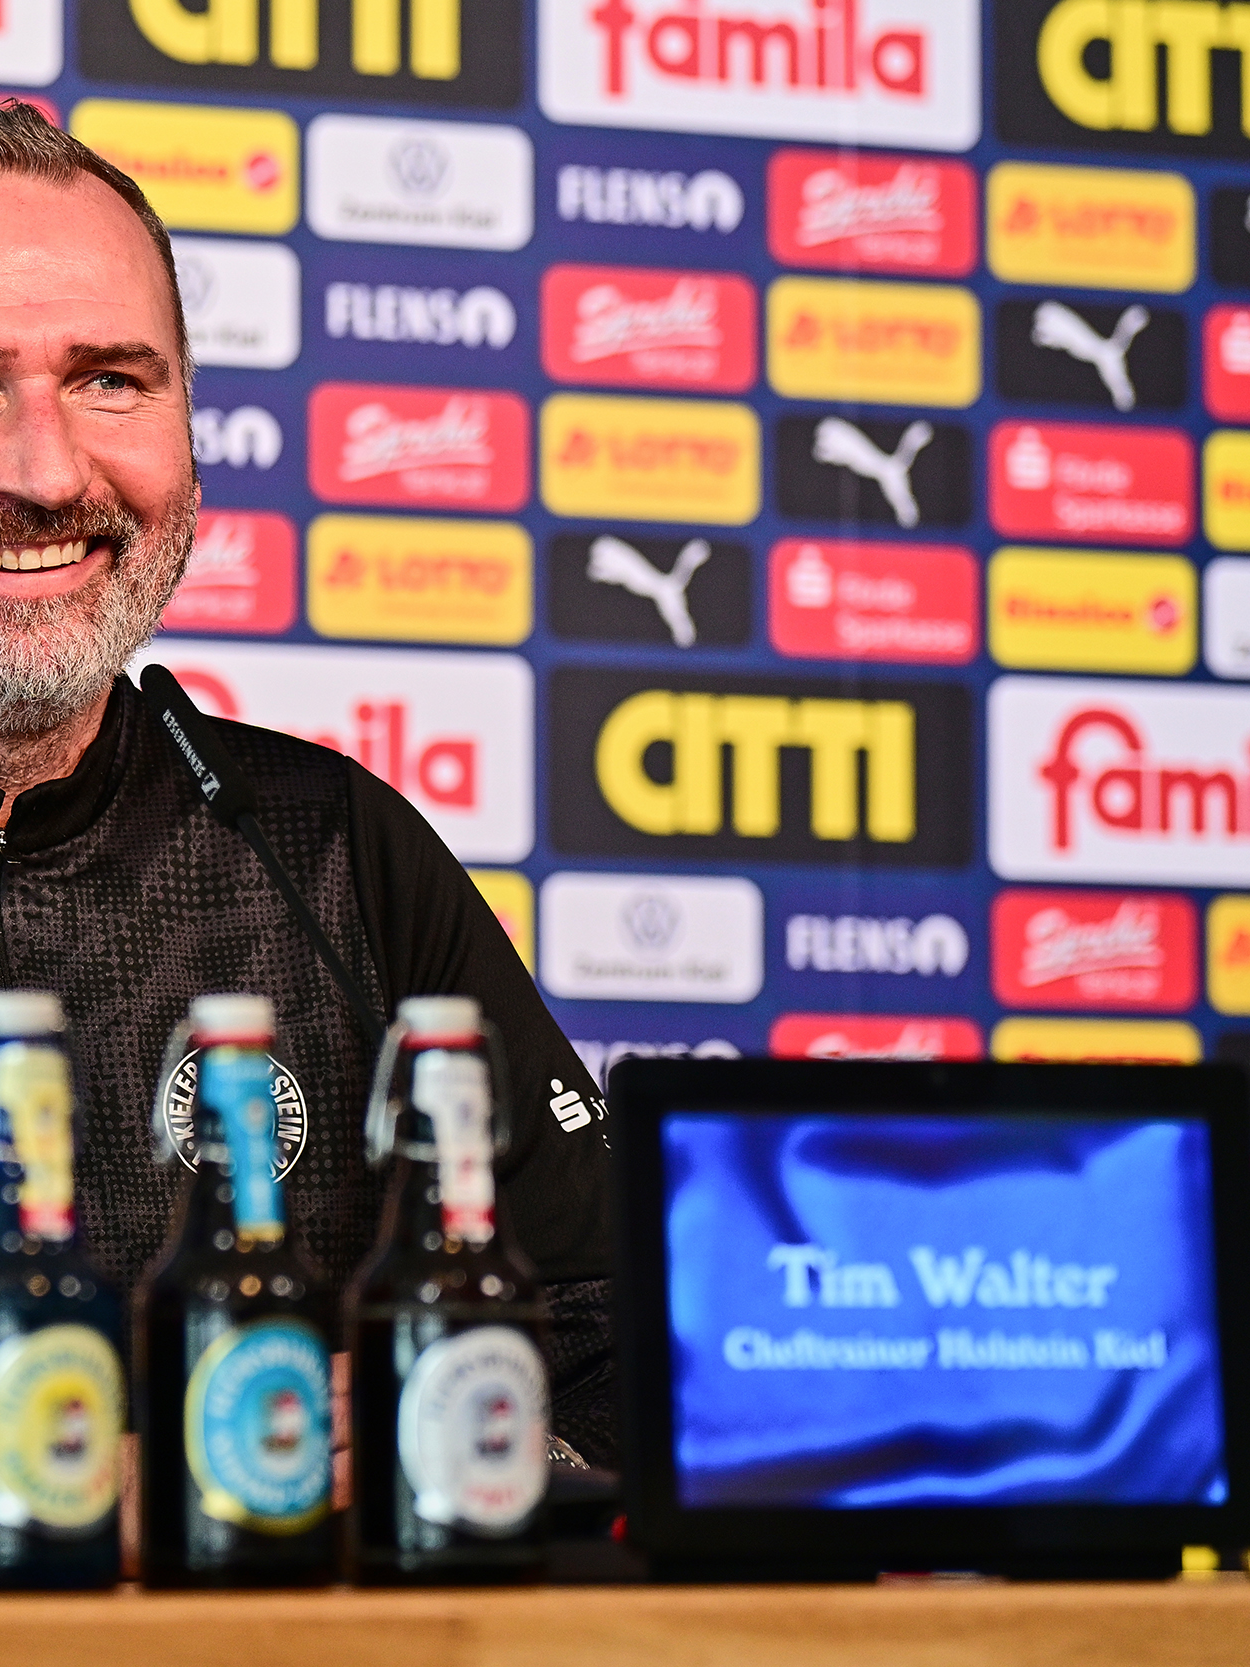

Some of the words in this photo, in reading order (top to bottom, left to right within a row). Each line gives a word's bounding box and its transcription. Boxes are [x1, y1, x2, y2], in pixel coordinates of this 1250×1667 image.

[162, 708, 207, 778] SENNHEISER
[596, 690, 914, 841] CITTI
[768, 1244, 900, 1308] Tim
[909, 1246, 1117, 1307] Walter
